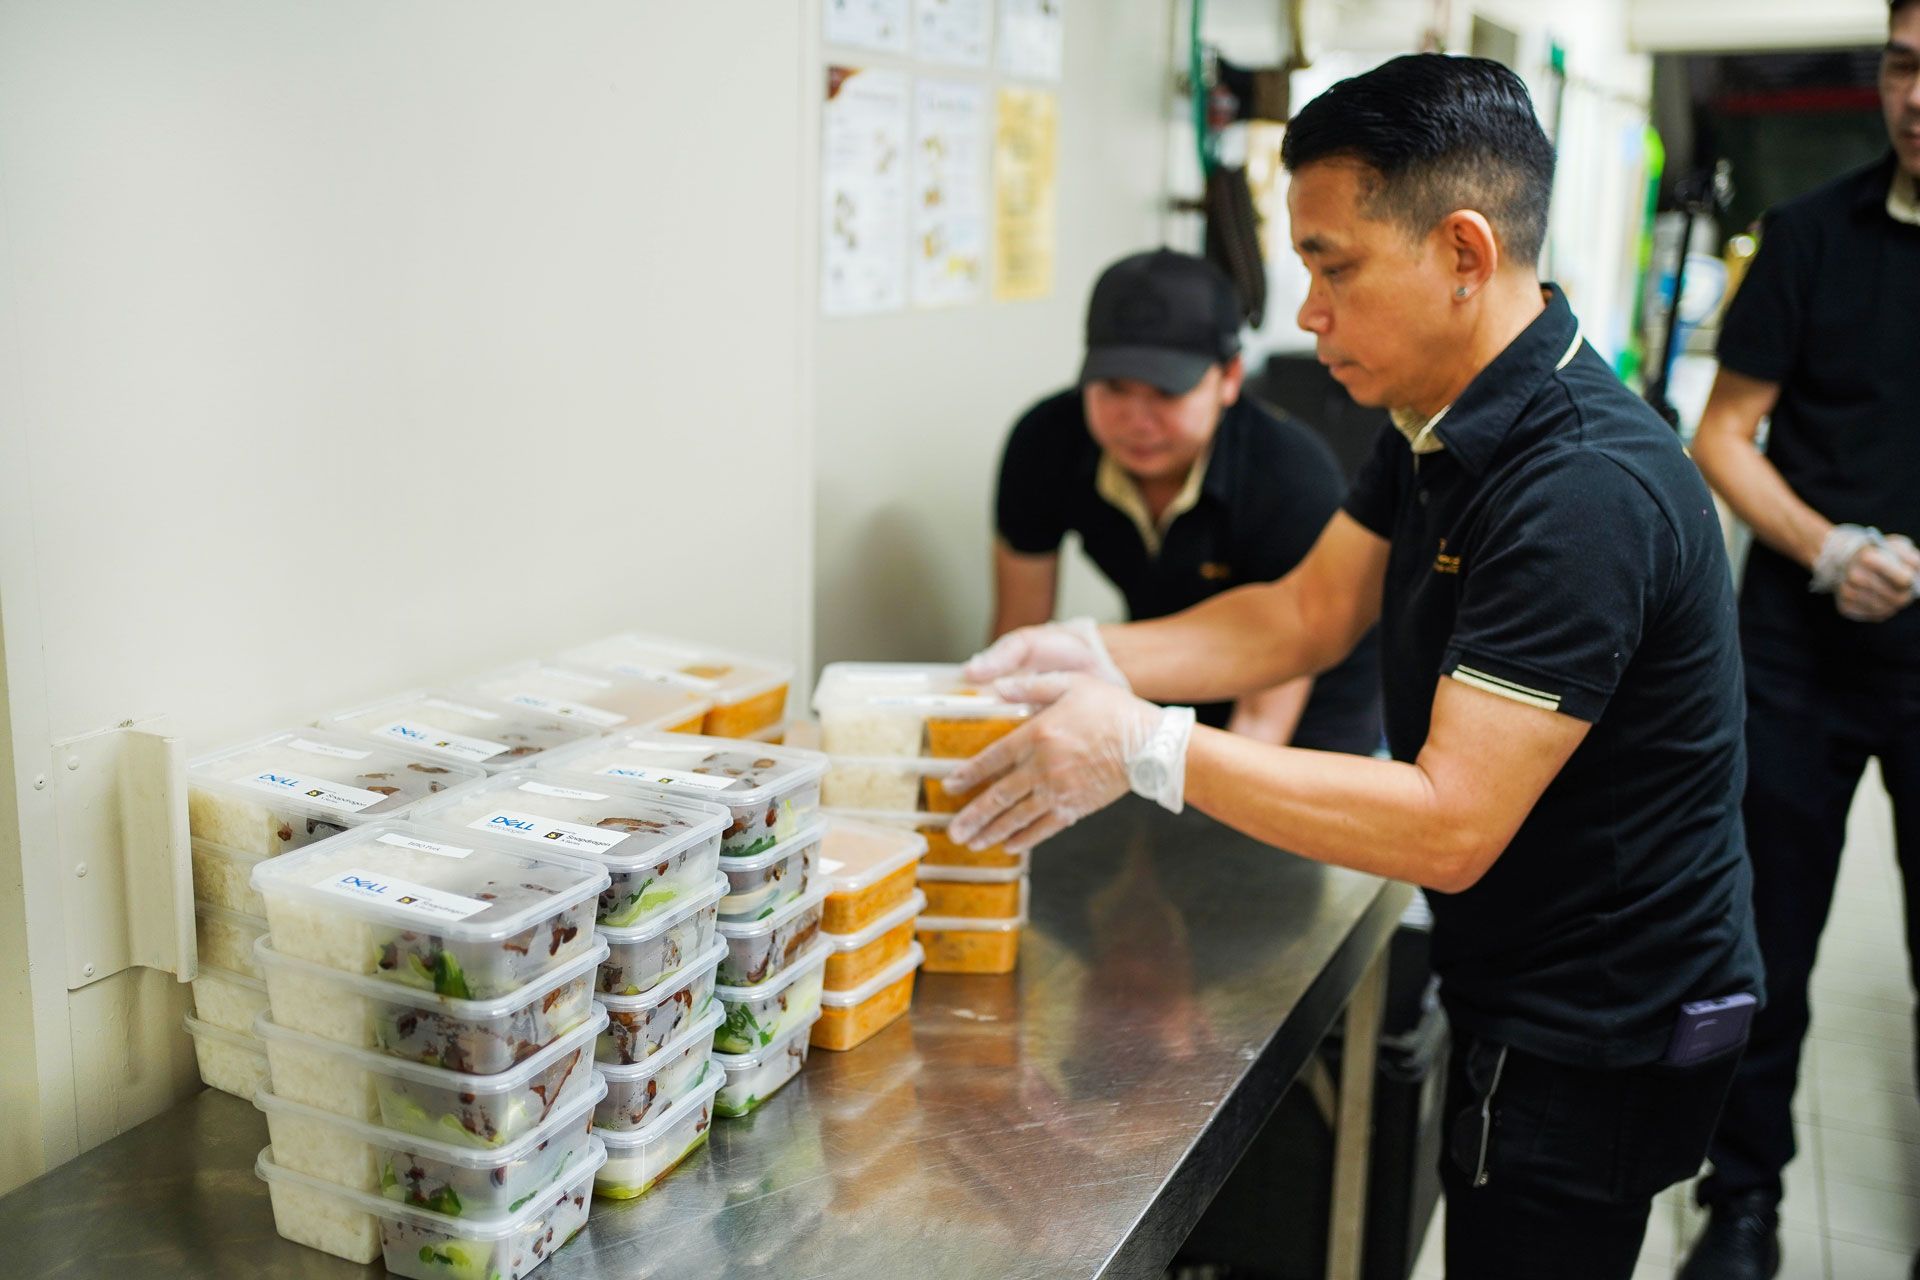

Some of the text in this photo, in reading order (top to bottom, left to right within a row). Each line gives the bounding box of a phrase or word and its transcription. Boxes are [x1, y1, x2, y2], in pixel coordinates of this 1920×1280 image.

[490, 815, 534, 831] DELL
[566, 834, 612, 848] Snapdragon
[341, 875, 388, 894] DELL
